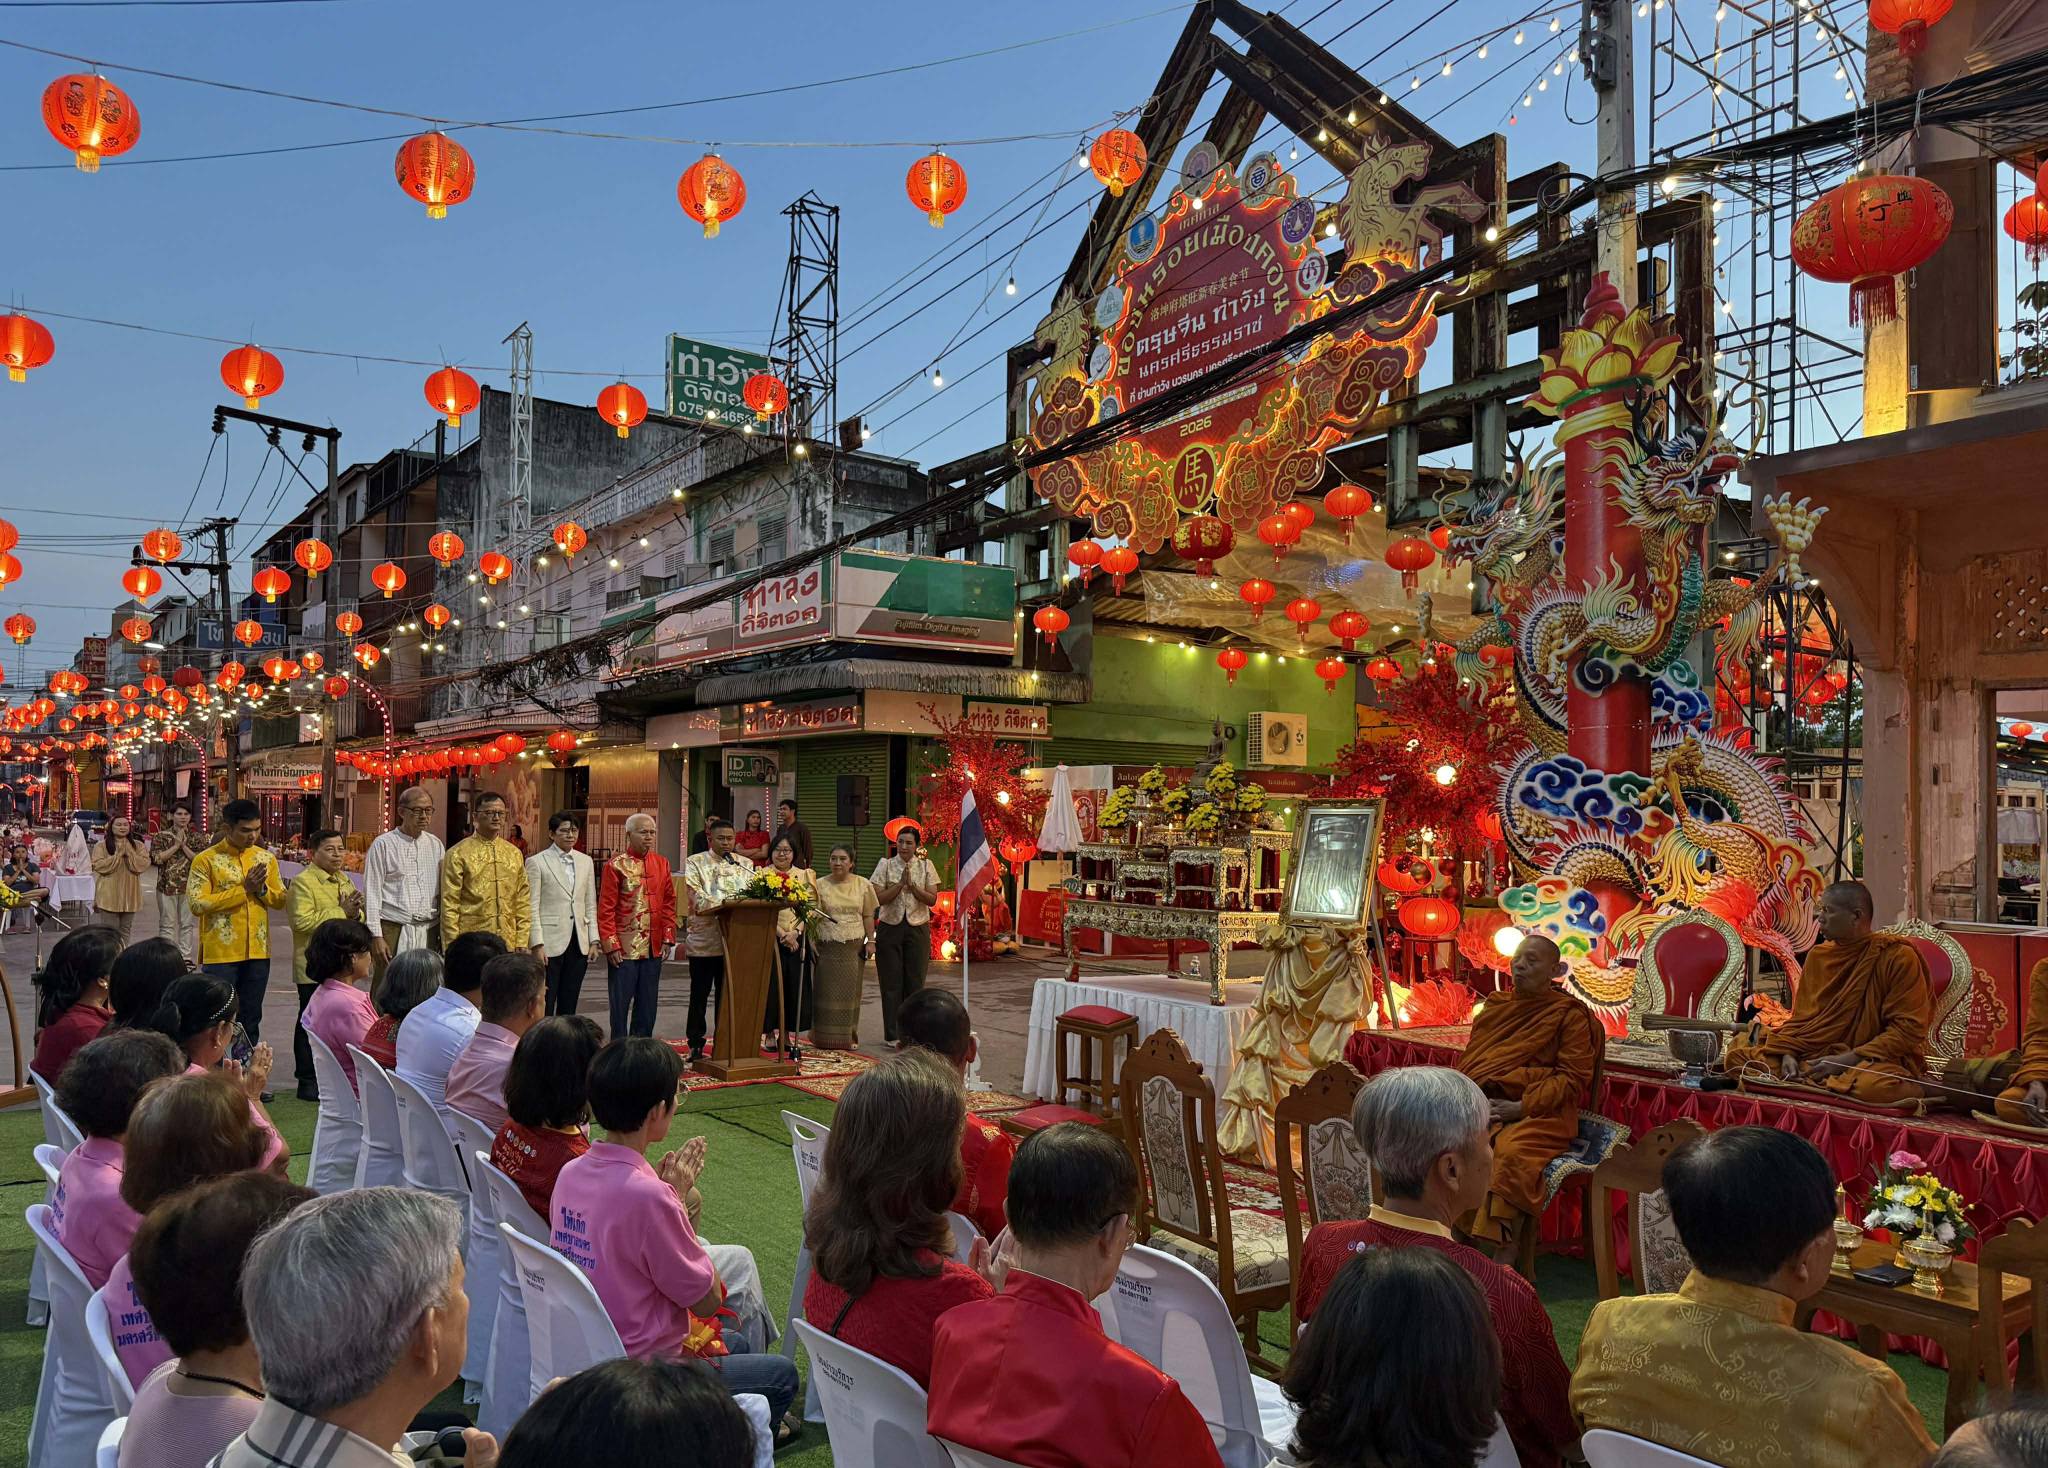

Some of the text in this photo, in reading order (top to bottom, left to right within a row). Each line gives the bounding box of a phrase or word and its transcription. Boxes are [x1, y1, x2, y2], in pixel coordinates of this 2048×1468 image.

[1136, 287, 1266, 357] ตรุษจีน ท่าวัง
[1138, 314, 1263, 379] นครศรีธรรมราช
[683, 379, 757, 411] ดิจิตอ
[1179, 415, 1213, 437] 2026
[1178, 449, 1209, 502] 馬
[925, 622, 949, 633] Digital
[729, 757, 744, 770] ID
